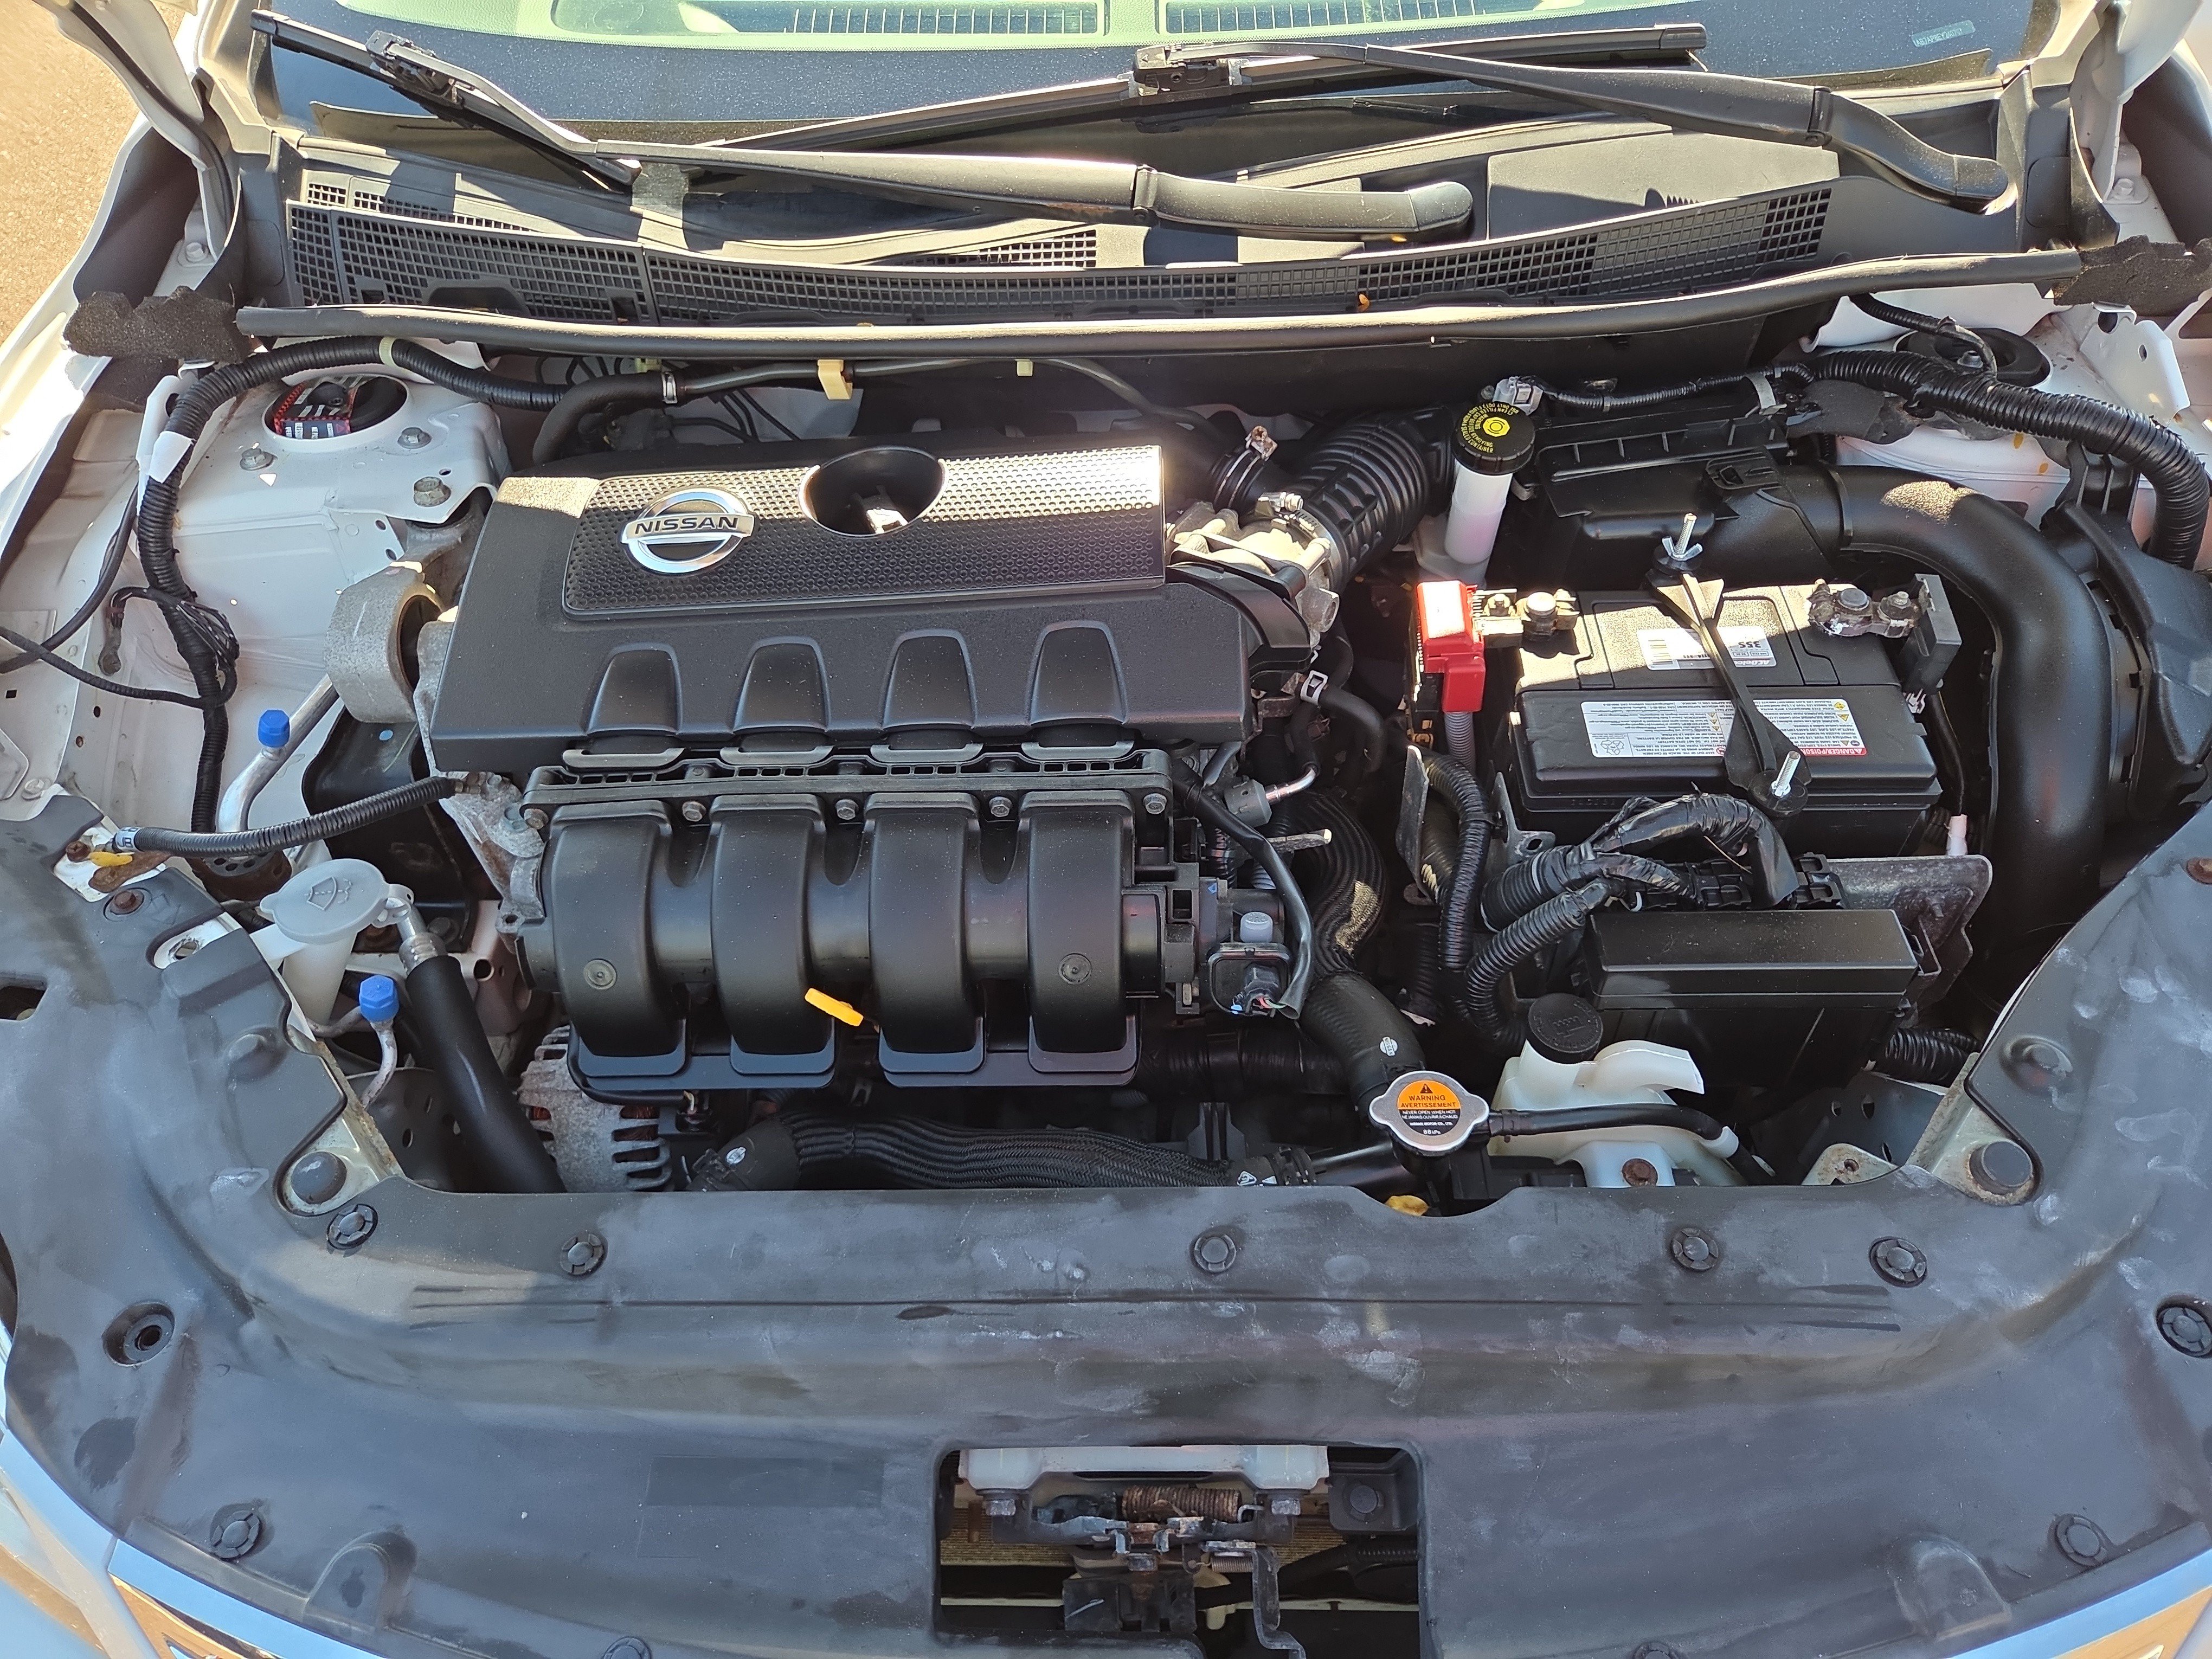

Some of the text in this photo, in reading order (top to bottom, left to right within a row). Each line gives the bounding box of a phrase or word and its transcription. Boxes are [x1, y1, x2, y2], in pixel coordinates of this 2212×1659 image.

[1468, 439, 1494, 453] CONTAINER
[1471, 433, 1493, 447] REMOVING
[635, 517, 738, 535] NISSAN
